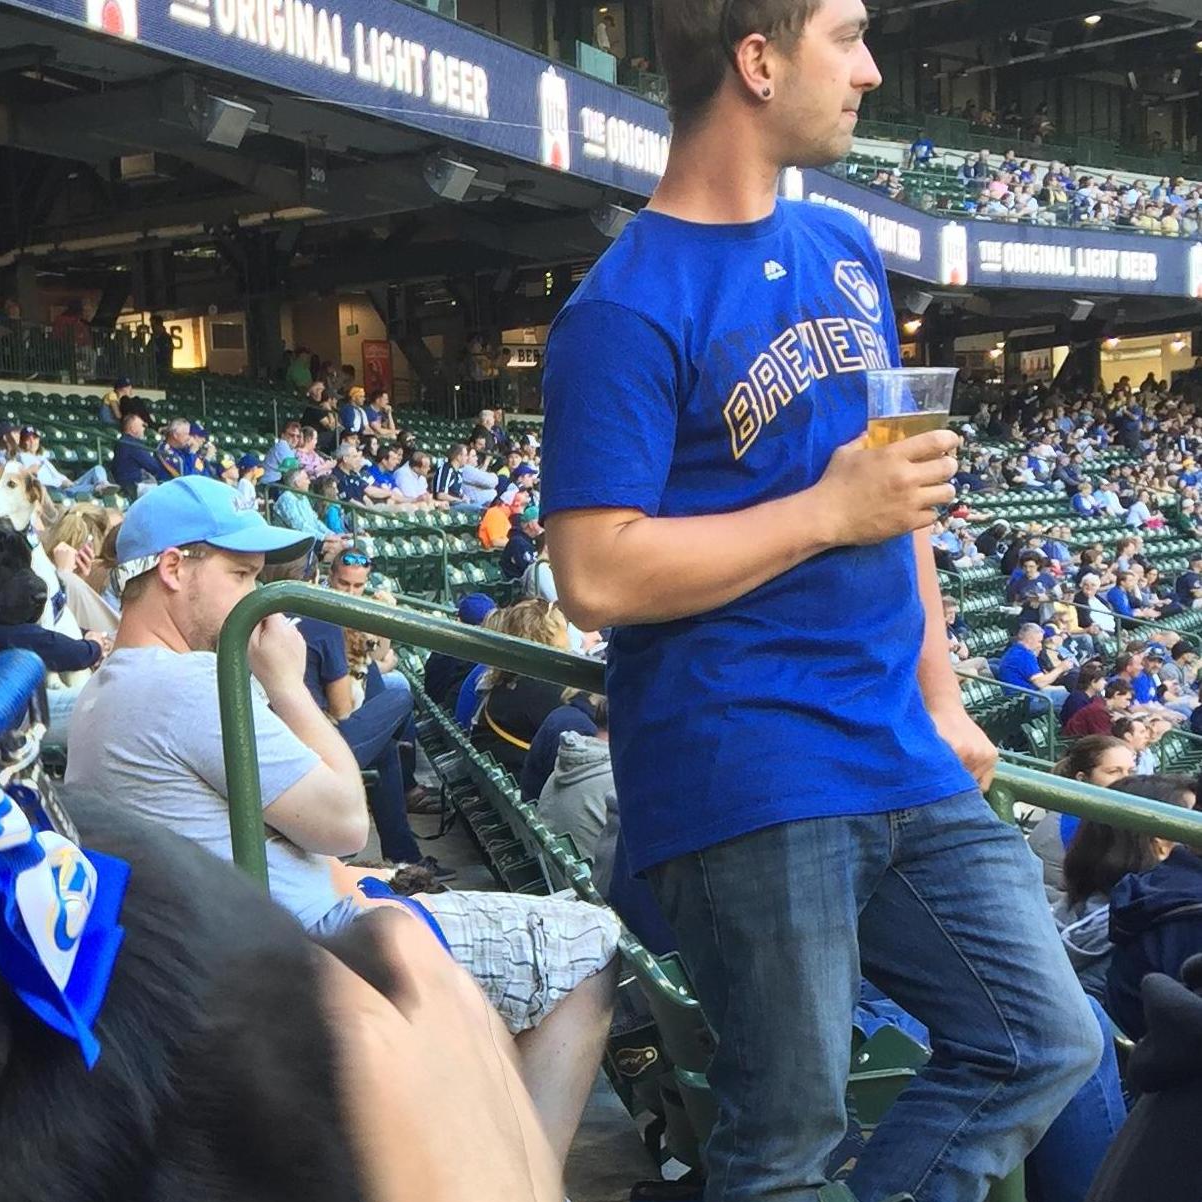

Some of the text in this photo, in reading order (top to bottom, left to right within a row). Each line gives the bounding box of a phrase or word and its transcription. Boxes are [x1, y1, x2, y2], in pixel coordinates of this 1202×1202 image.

[214, 0, 489, 119] ORIGINAL LIGHT BEER
[581, 107, 669, 176] THE ORIGINA
[979, 241, 1157, 281] THE ORIGINAL LIGHT BEER
[723, 317, 891, 460] BREWER
